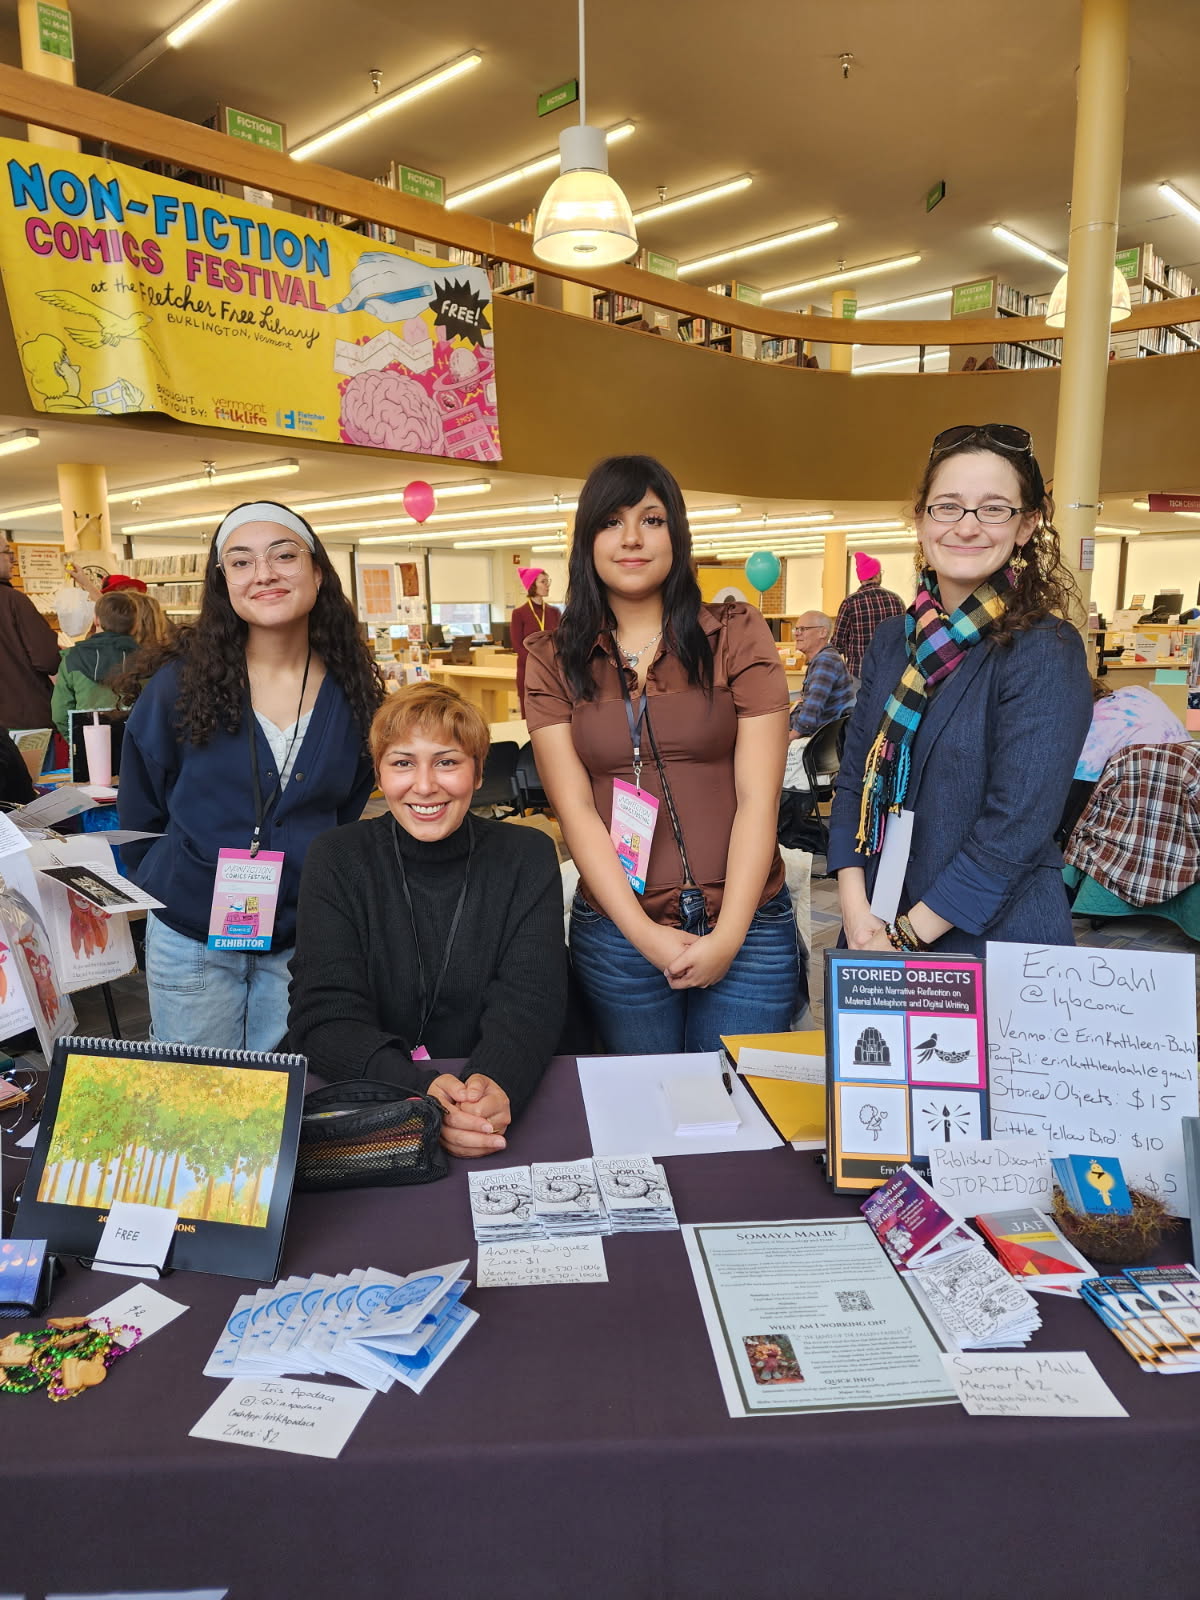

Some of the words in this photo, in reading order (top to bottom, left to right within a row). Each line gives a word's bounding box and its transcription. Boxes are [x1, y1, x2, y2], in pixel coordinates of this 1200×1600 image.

[237, 116, 272, 135] FICTION
[408, 173, 435, 188] FICTION
[7, 158, 331, 278] NON-FICTION
[25, 217, 164, 275] COMICS
[186, 249, 328, 313] FESTIVAL
[91, 282, 108, 293] at
[115, 274, 138, 293] the
[138, 282, 216, 318] Fletcher
[220, 301, 257, 326] Free
[260, 305, 320, 349] Library
[441, 300, 480, 327] FREE!
[167, 313, 251, 340] BURLINGTON,
[254, 332, 293, 350] Vermont
[156, 384, 195, 405] BROUGHT
[191, 409, 207, 418] BY:
[212, 397, 267, 414] vermont
[215, 939, 265, 948] EXHIBITOR
[842, 968, 901, 982] STORIED
[906, 970, 971, 984] OBJECTS
[1023, 949, 1082, 983] Erin
[1088, 956, 1156, 993] Bahl
[852, 985, 859, 993] A
[859, 985, 884, 996] Graphic
[885, 986, 916, 996] Narrative
[917, 987, 951, 998] Reflection
[952, 990, 962, 998] on
[845, 996, 872, 1007] Material
[873, 997, 907, 1009] Metaphors
[909, 998, 922, 1008] and
[923, 999, 944, 1010] Digital
[945, 1000, 969, 1011] Writing
[1020, 985, 1134, 1021] @lybcomic
[999, 1010, 1052, 1042] Venmo:
[992, 1076, 1051, 1100] Storied
[1054, 1081, 1119, 1107] Objects:
[993, 1116, 1038, 1137] Little
[1042, 1122, 1085, 1145] Yellow
[1089, 1127, 1122, 1145] Bird:
[1131, 1133, 1164, 1151] $10
[597, 1157, 650, 1170] GATOR
[934, 1148, 994, 1170] Publisher
[534, 1164, 590, 1177] GATOR
[544, 1174, 582, 1182] WORLD
[608, 1169, 646, 1177] WORLD
[880, 1165, 895, 1175] Erin
[470, 1171, 527, 1186] GATOR
[891, 1180, 903, 1191] the
[939, 1173, 1049, 1198] STORIED20
[1144, 1173, 1178, 1194] $5
[481, 1183, 519, 1193] WORLD
[115, 1227, 141, 1241] FREE
[736, 1231, 792, 1241] SOMAYA
[794, 1229, 838, 1239] MALIK
[485, 1247, 530, 1257] Andrea
[531, 1243, 590, 1258] Rodriguez
[799, 1322, 813, 1330] AM
[814, 1321, 819, 1329] I
[820, 1320, 867, 1329] WORKING
[867, 1319, 888, 1327] ON?
[953, 1357, 1031, 1380] Somaya
[1036, 1360, 1085, 1375] Malik
[824, 1377, 851, 1386] QUICK
[853, 1376, 875, 1384] INFO
[259, 1382, 284, 1394] Iris
[291, 1387, 336, 1403] Apodaca
[262, 1426, 281, 1445] $2
